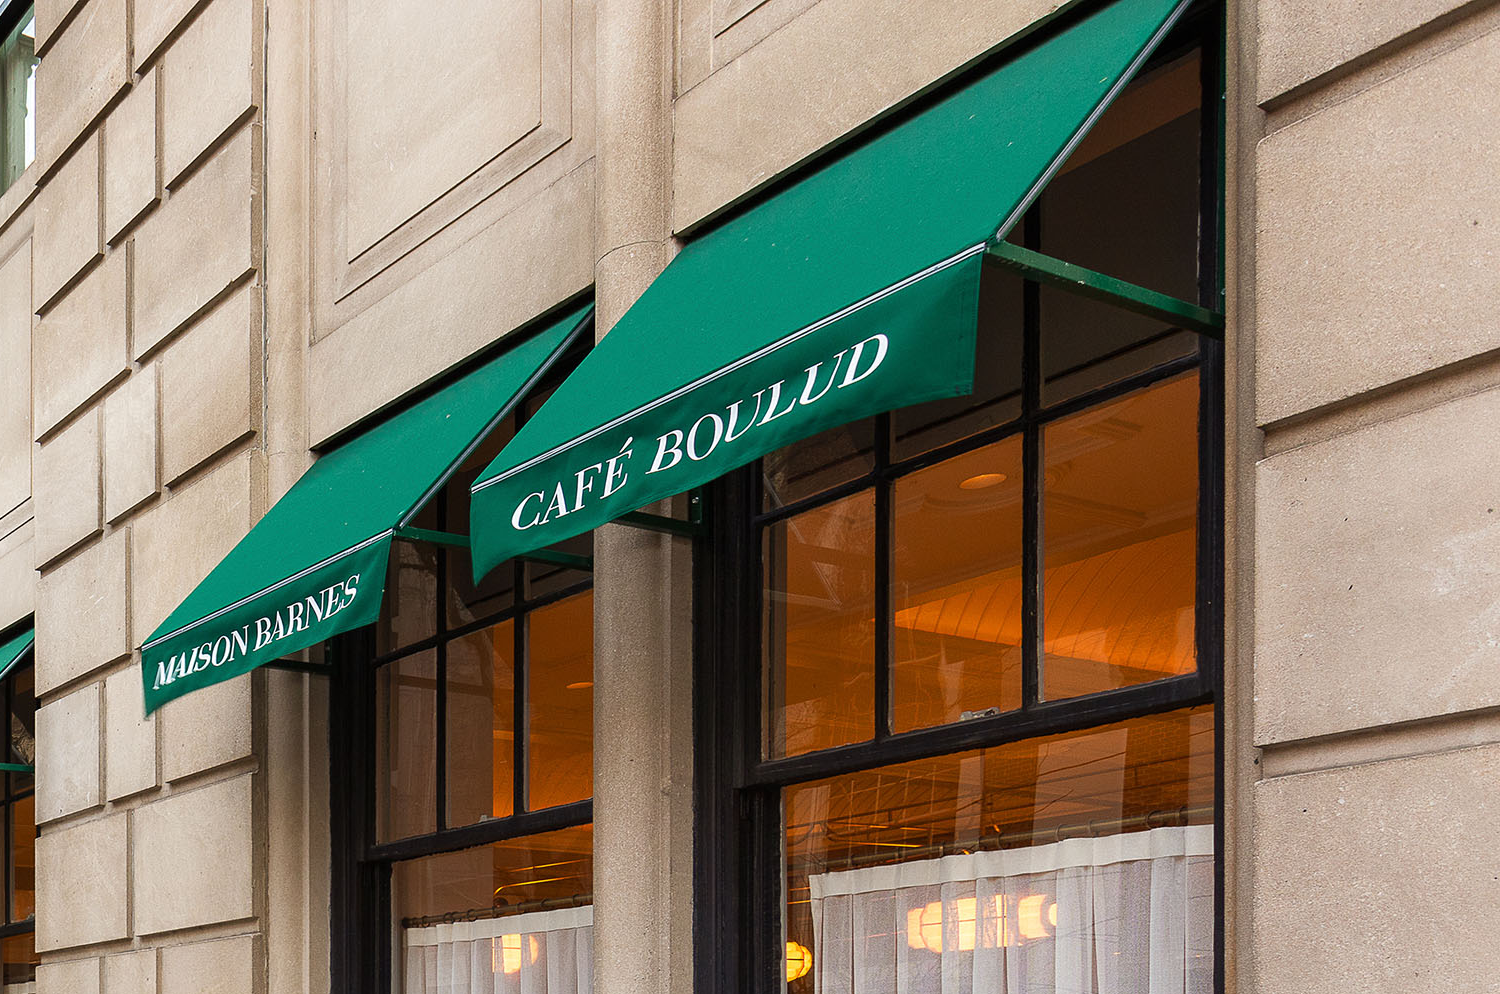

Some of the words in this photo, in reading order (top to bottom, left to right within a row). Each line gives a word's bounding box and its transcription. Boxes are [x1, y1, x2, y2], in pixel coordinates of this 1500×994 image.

[511, 436, 633, 530] CAFÉ
[645, 333, 889, 475] BOULUD
[152, 624, 249, 690] MAISON
[253, 574, 360, 652] BARNES
